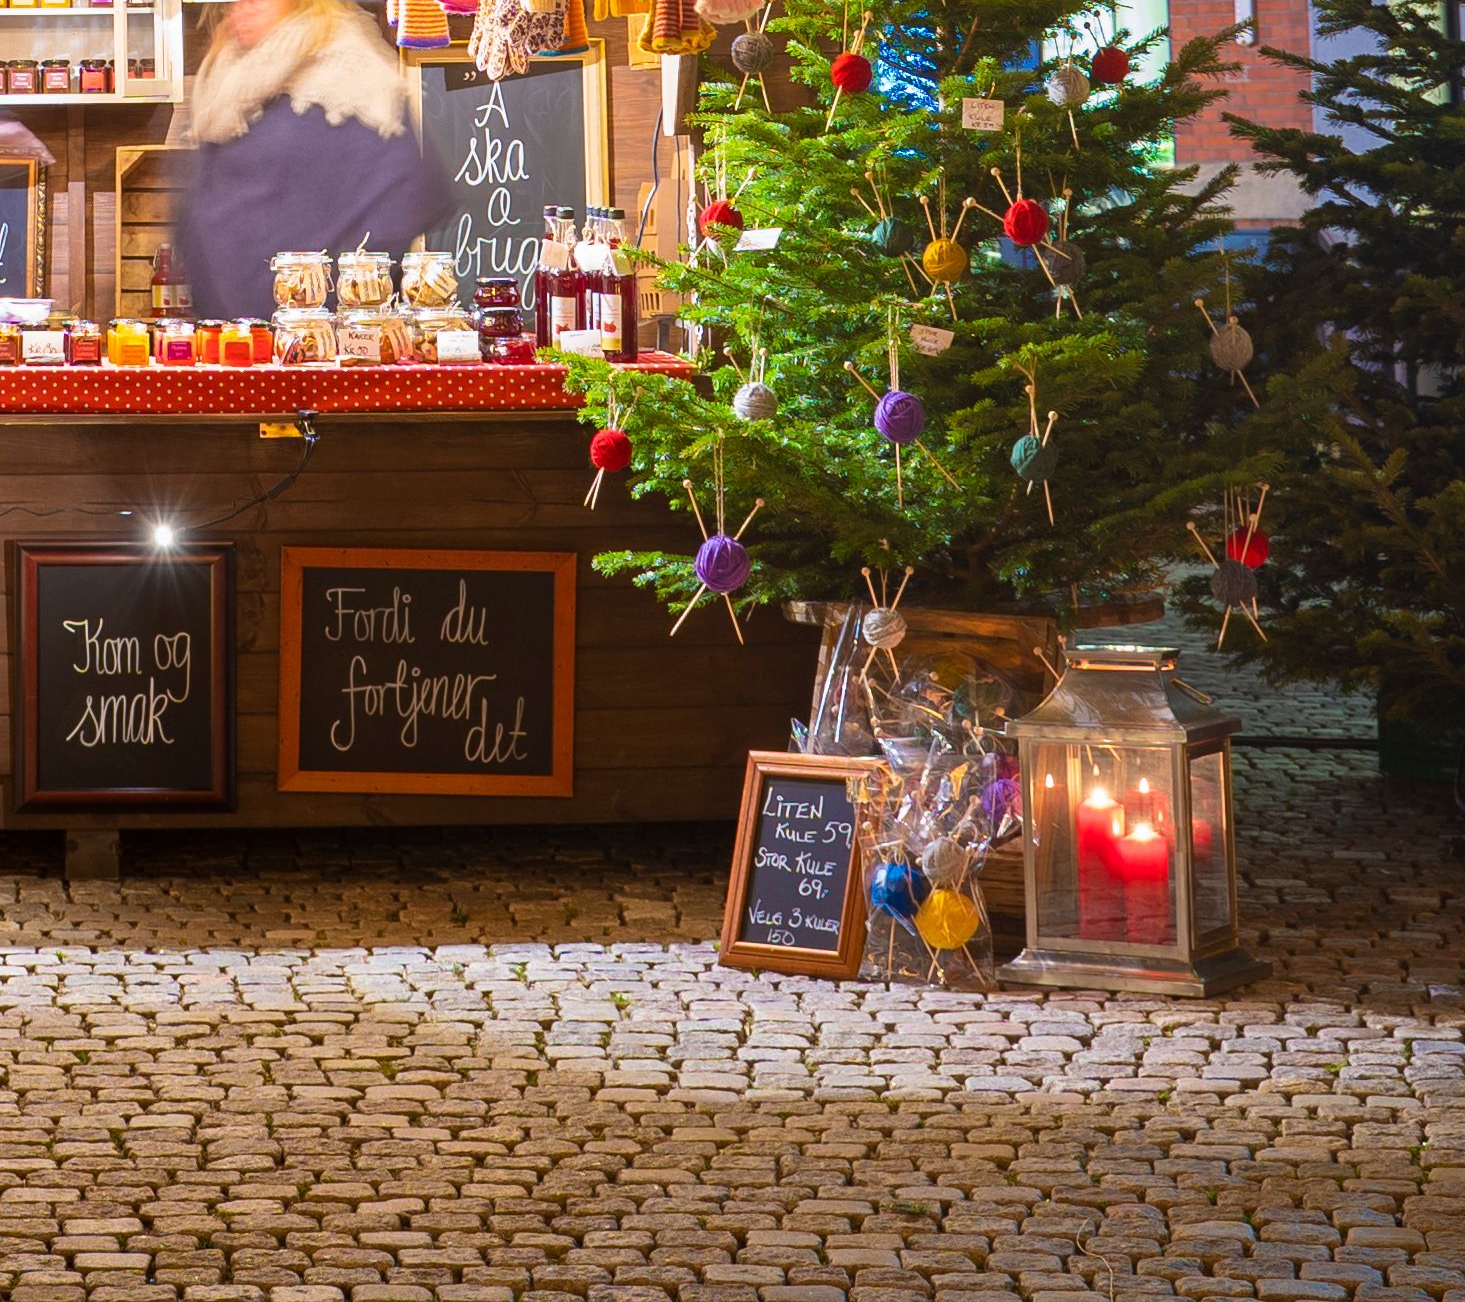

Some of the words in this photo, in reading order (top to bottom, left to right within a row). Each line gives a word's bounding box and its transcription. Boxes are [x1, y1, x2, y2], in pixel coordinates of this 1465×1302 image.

[454, 128, 529, 186] ska
[325, 586, 416, 644] Fordi
[440, 578, 489, 646] du
[62, 617, 142, 675] Kom
[154, 632, 191, 703] og
[65, 676, 175, 747] smak
[330, 655, 497, 751] fortjener
[465, 696, 528, 764] det
[754, 847, 792, 873] STOR
[795, 851, 838, 876] KULE
[775, 822, 818, 843] KULE
[748, 899, 783, 925] VELG
[788, 908, 803, 928] 3
[805, 915, 841, 935] KULER
[767, 929, 796, 946] 150
